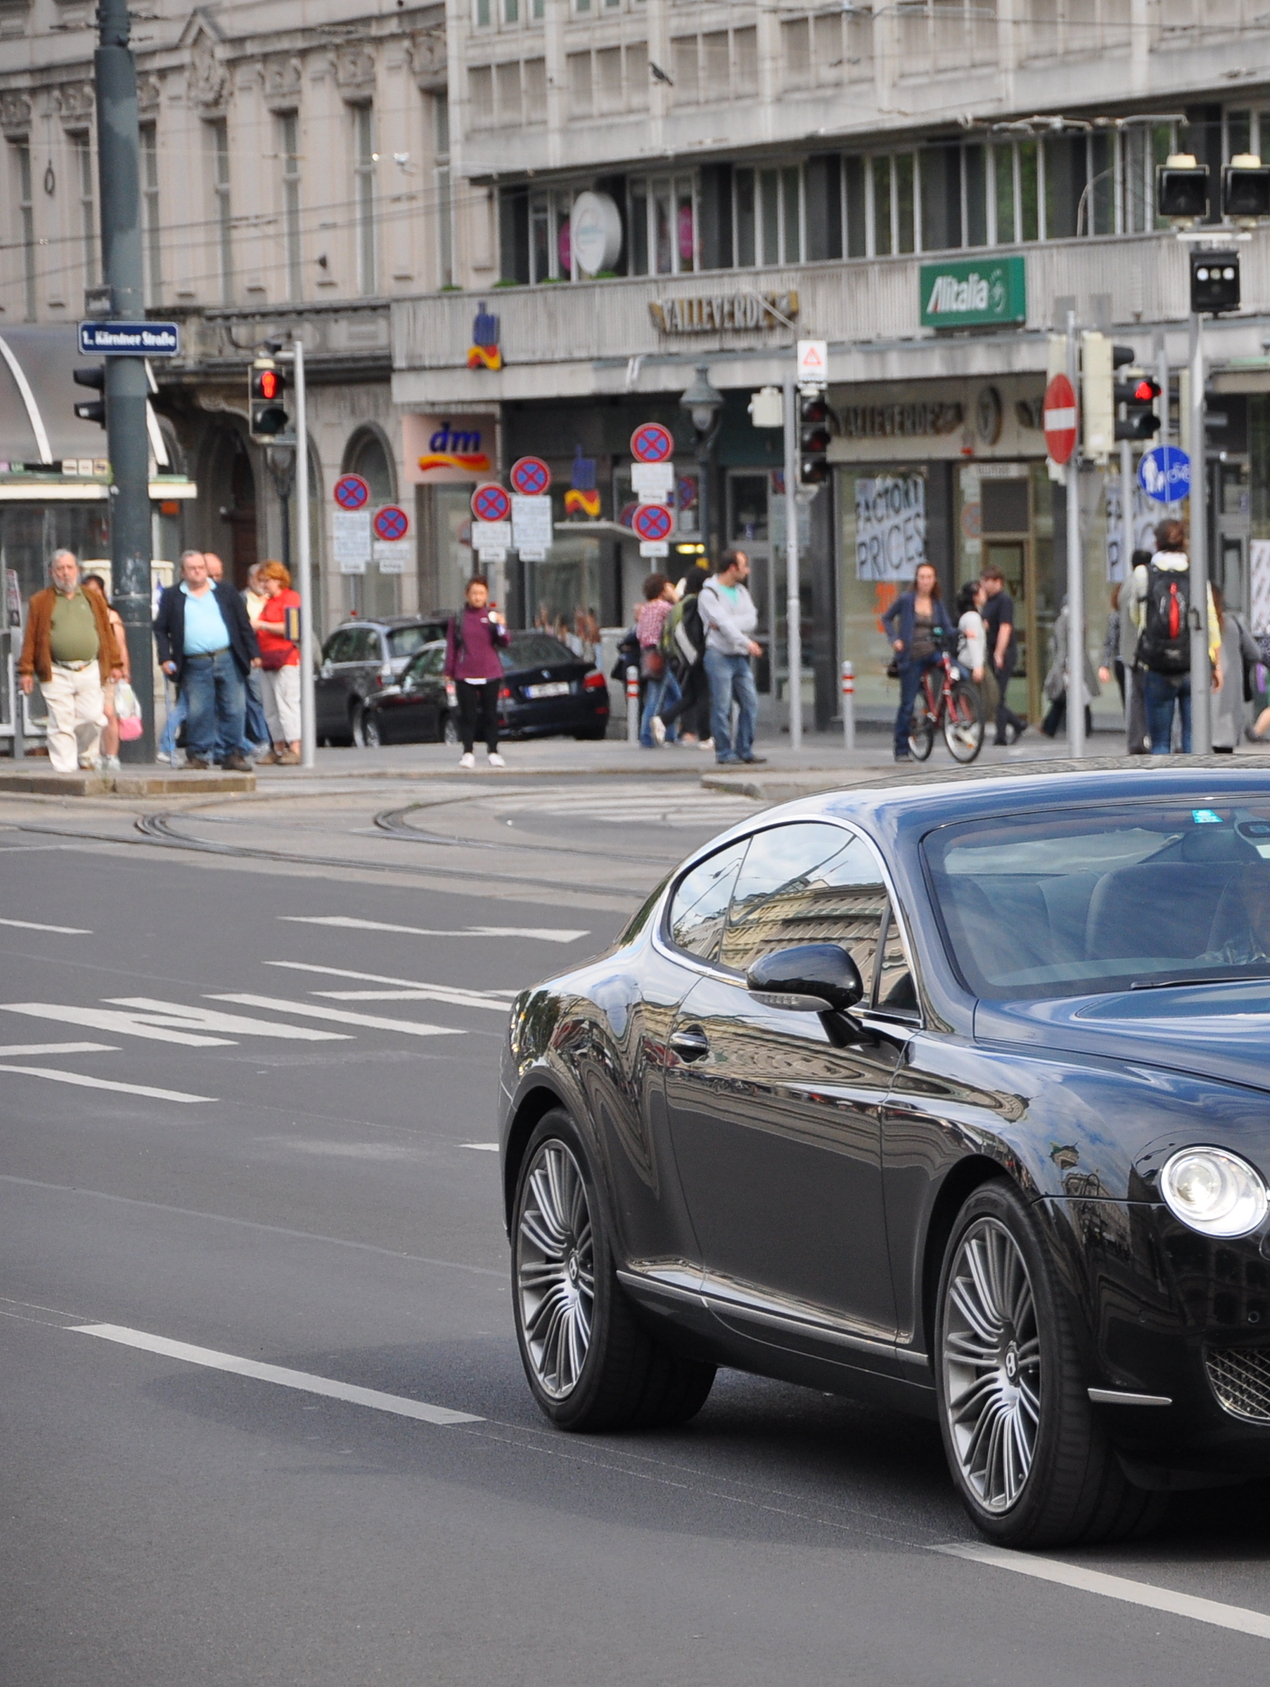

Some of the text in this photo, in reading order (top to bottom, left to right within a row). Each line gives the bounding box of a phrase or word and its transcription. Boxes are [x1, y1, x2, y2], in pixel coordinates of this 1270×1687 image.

[661, 293, 768, 333] VALLEVERDE
[926, 272, 989, 315] Alitalia
[429, 421, 482, 453] dm
[856, 511, 925, 579] PRICES
